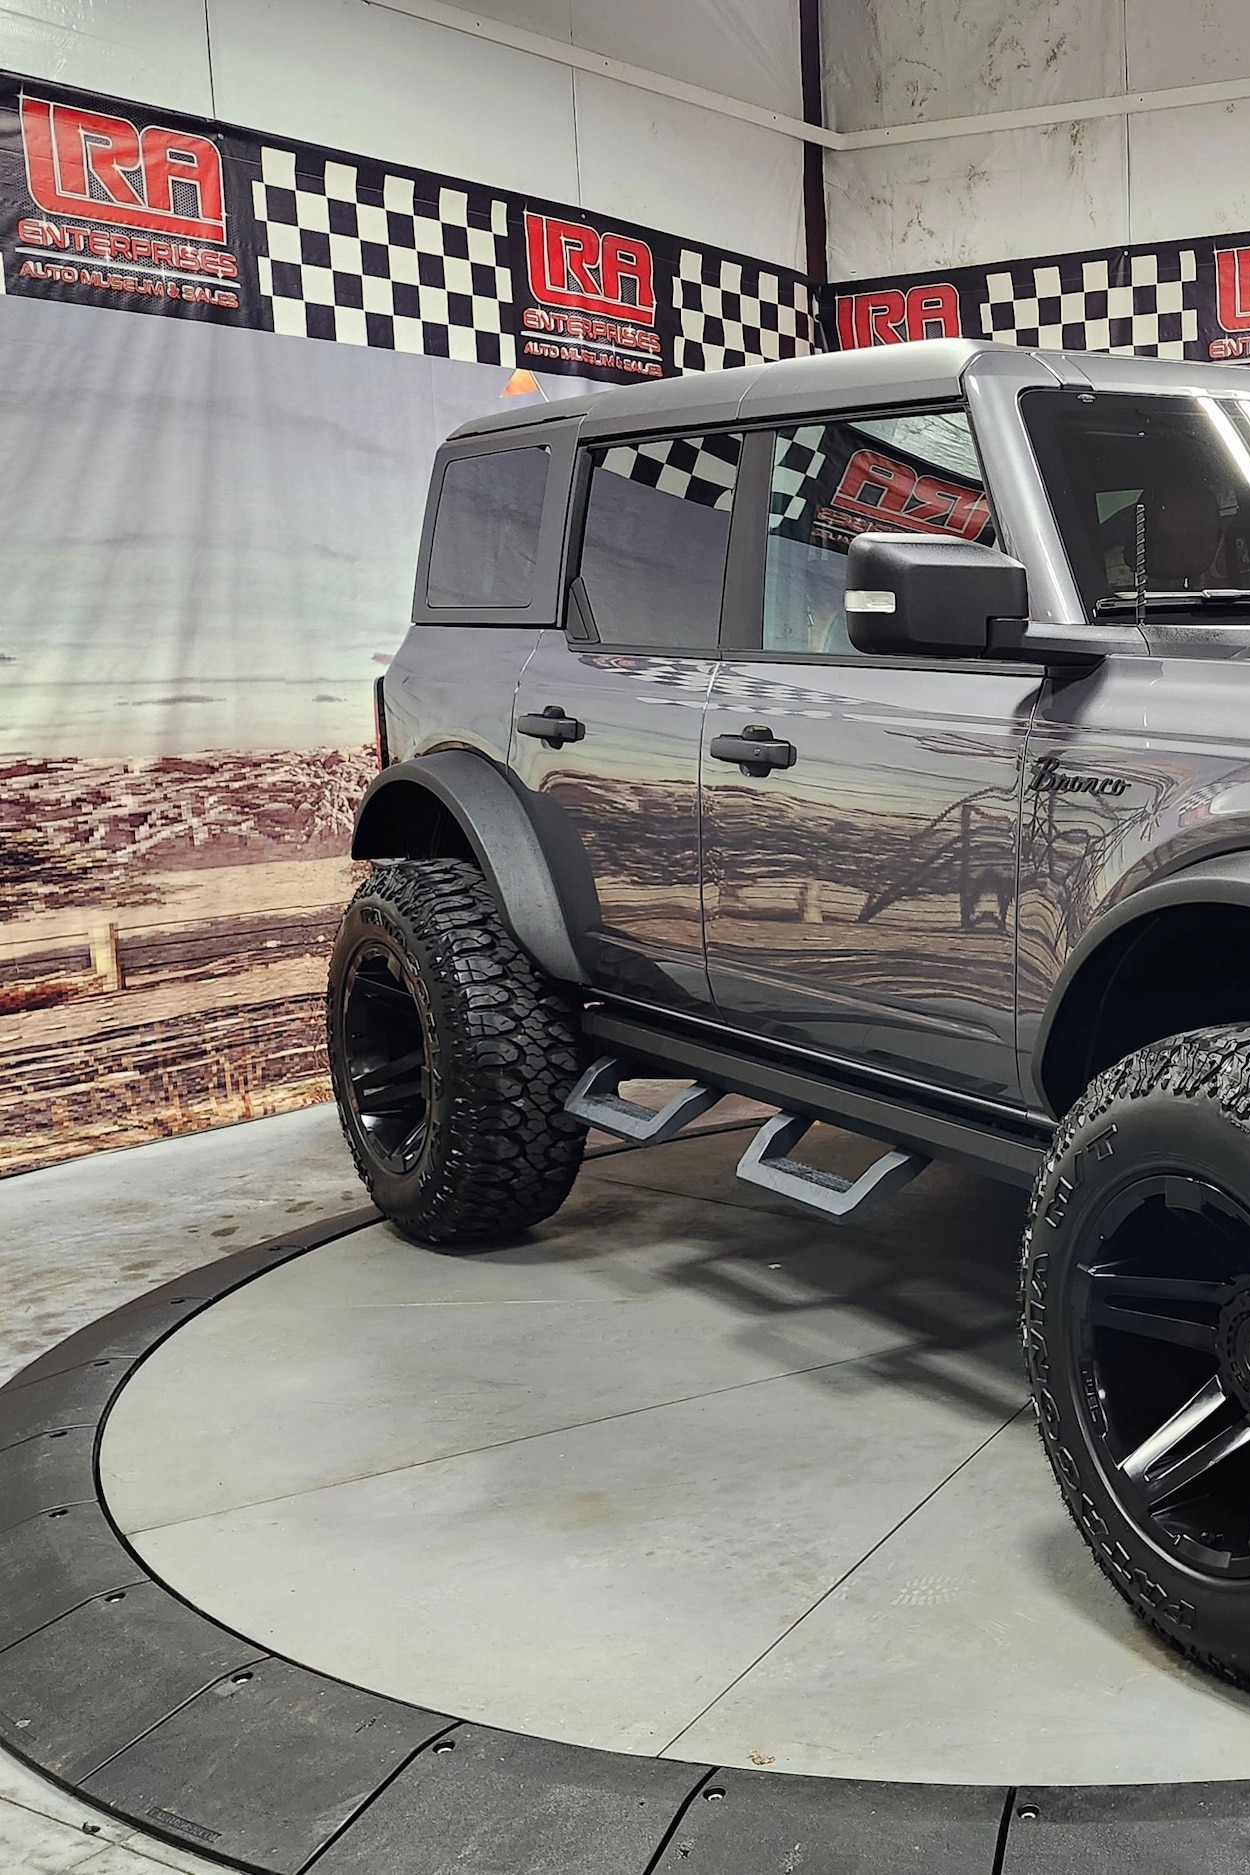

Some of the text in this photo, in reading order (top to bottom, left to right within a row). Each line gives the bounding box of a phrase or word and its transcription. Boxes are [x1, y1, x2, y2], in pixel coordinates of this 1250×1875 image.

[17, 218, 239, 278] ENTERPRISES
[20, 261, 239, 309] AUTO MUSEUM & SALES
[523, 308, 661, 353] ENTERPRISES
[524, 341, 560, 358] AUTO
[1028, 756, 1132, 796] Bronco
[1028, 1253, 1196, 1630] PATAGONIA
